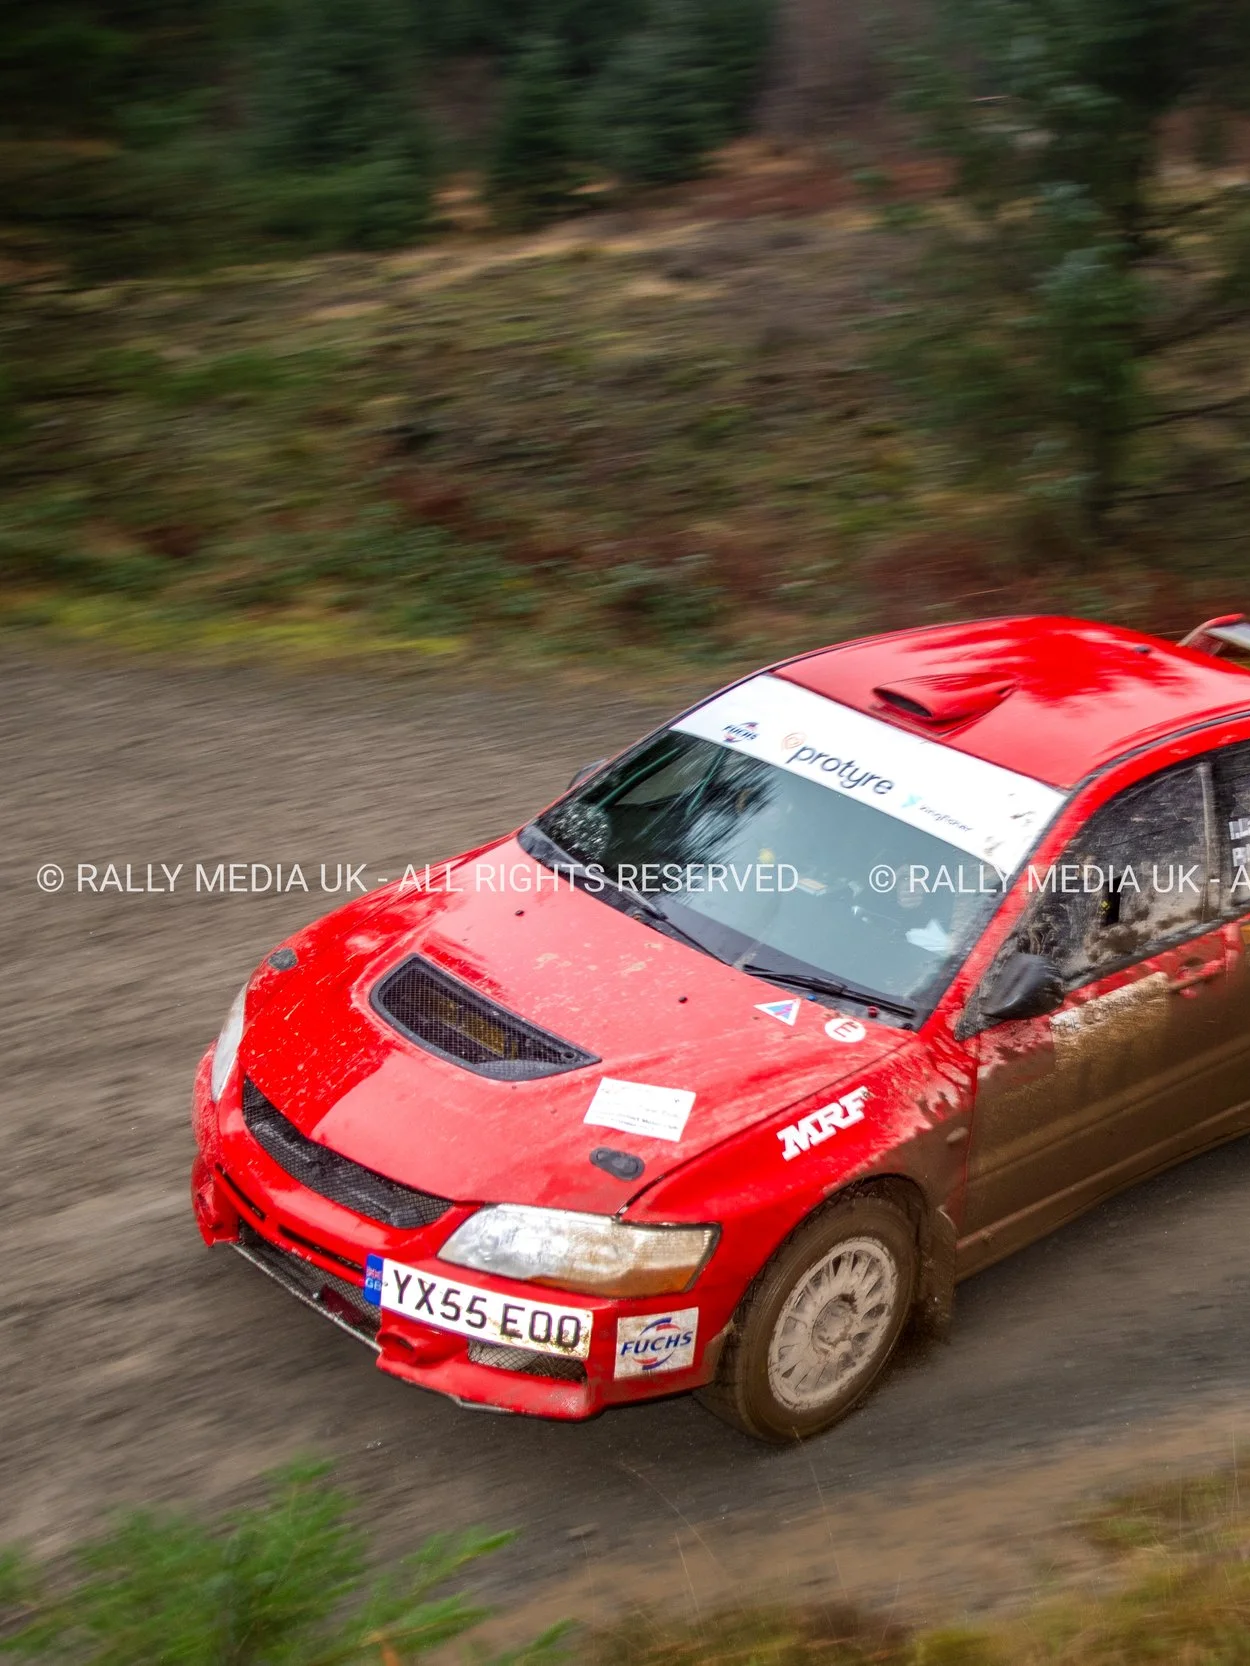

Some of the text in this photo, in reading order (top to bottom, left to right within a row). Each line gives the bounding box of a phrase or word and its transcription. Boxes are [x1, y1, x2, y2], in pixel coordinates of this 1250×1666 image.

[785, 745, 894, 795] protyre
[833, 1021, 859, 1038] E
[776, 1086, 868, 1161] MRF
[365, 1277, 382, 1291] GB
[393, 1269, 488, 1329] YX55
[620, 1330, 693, 1357] FUCHS
